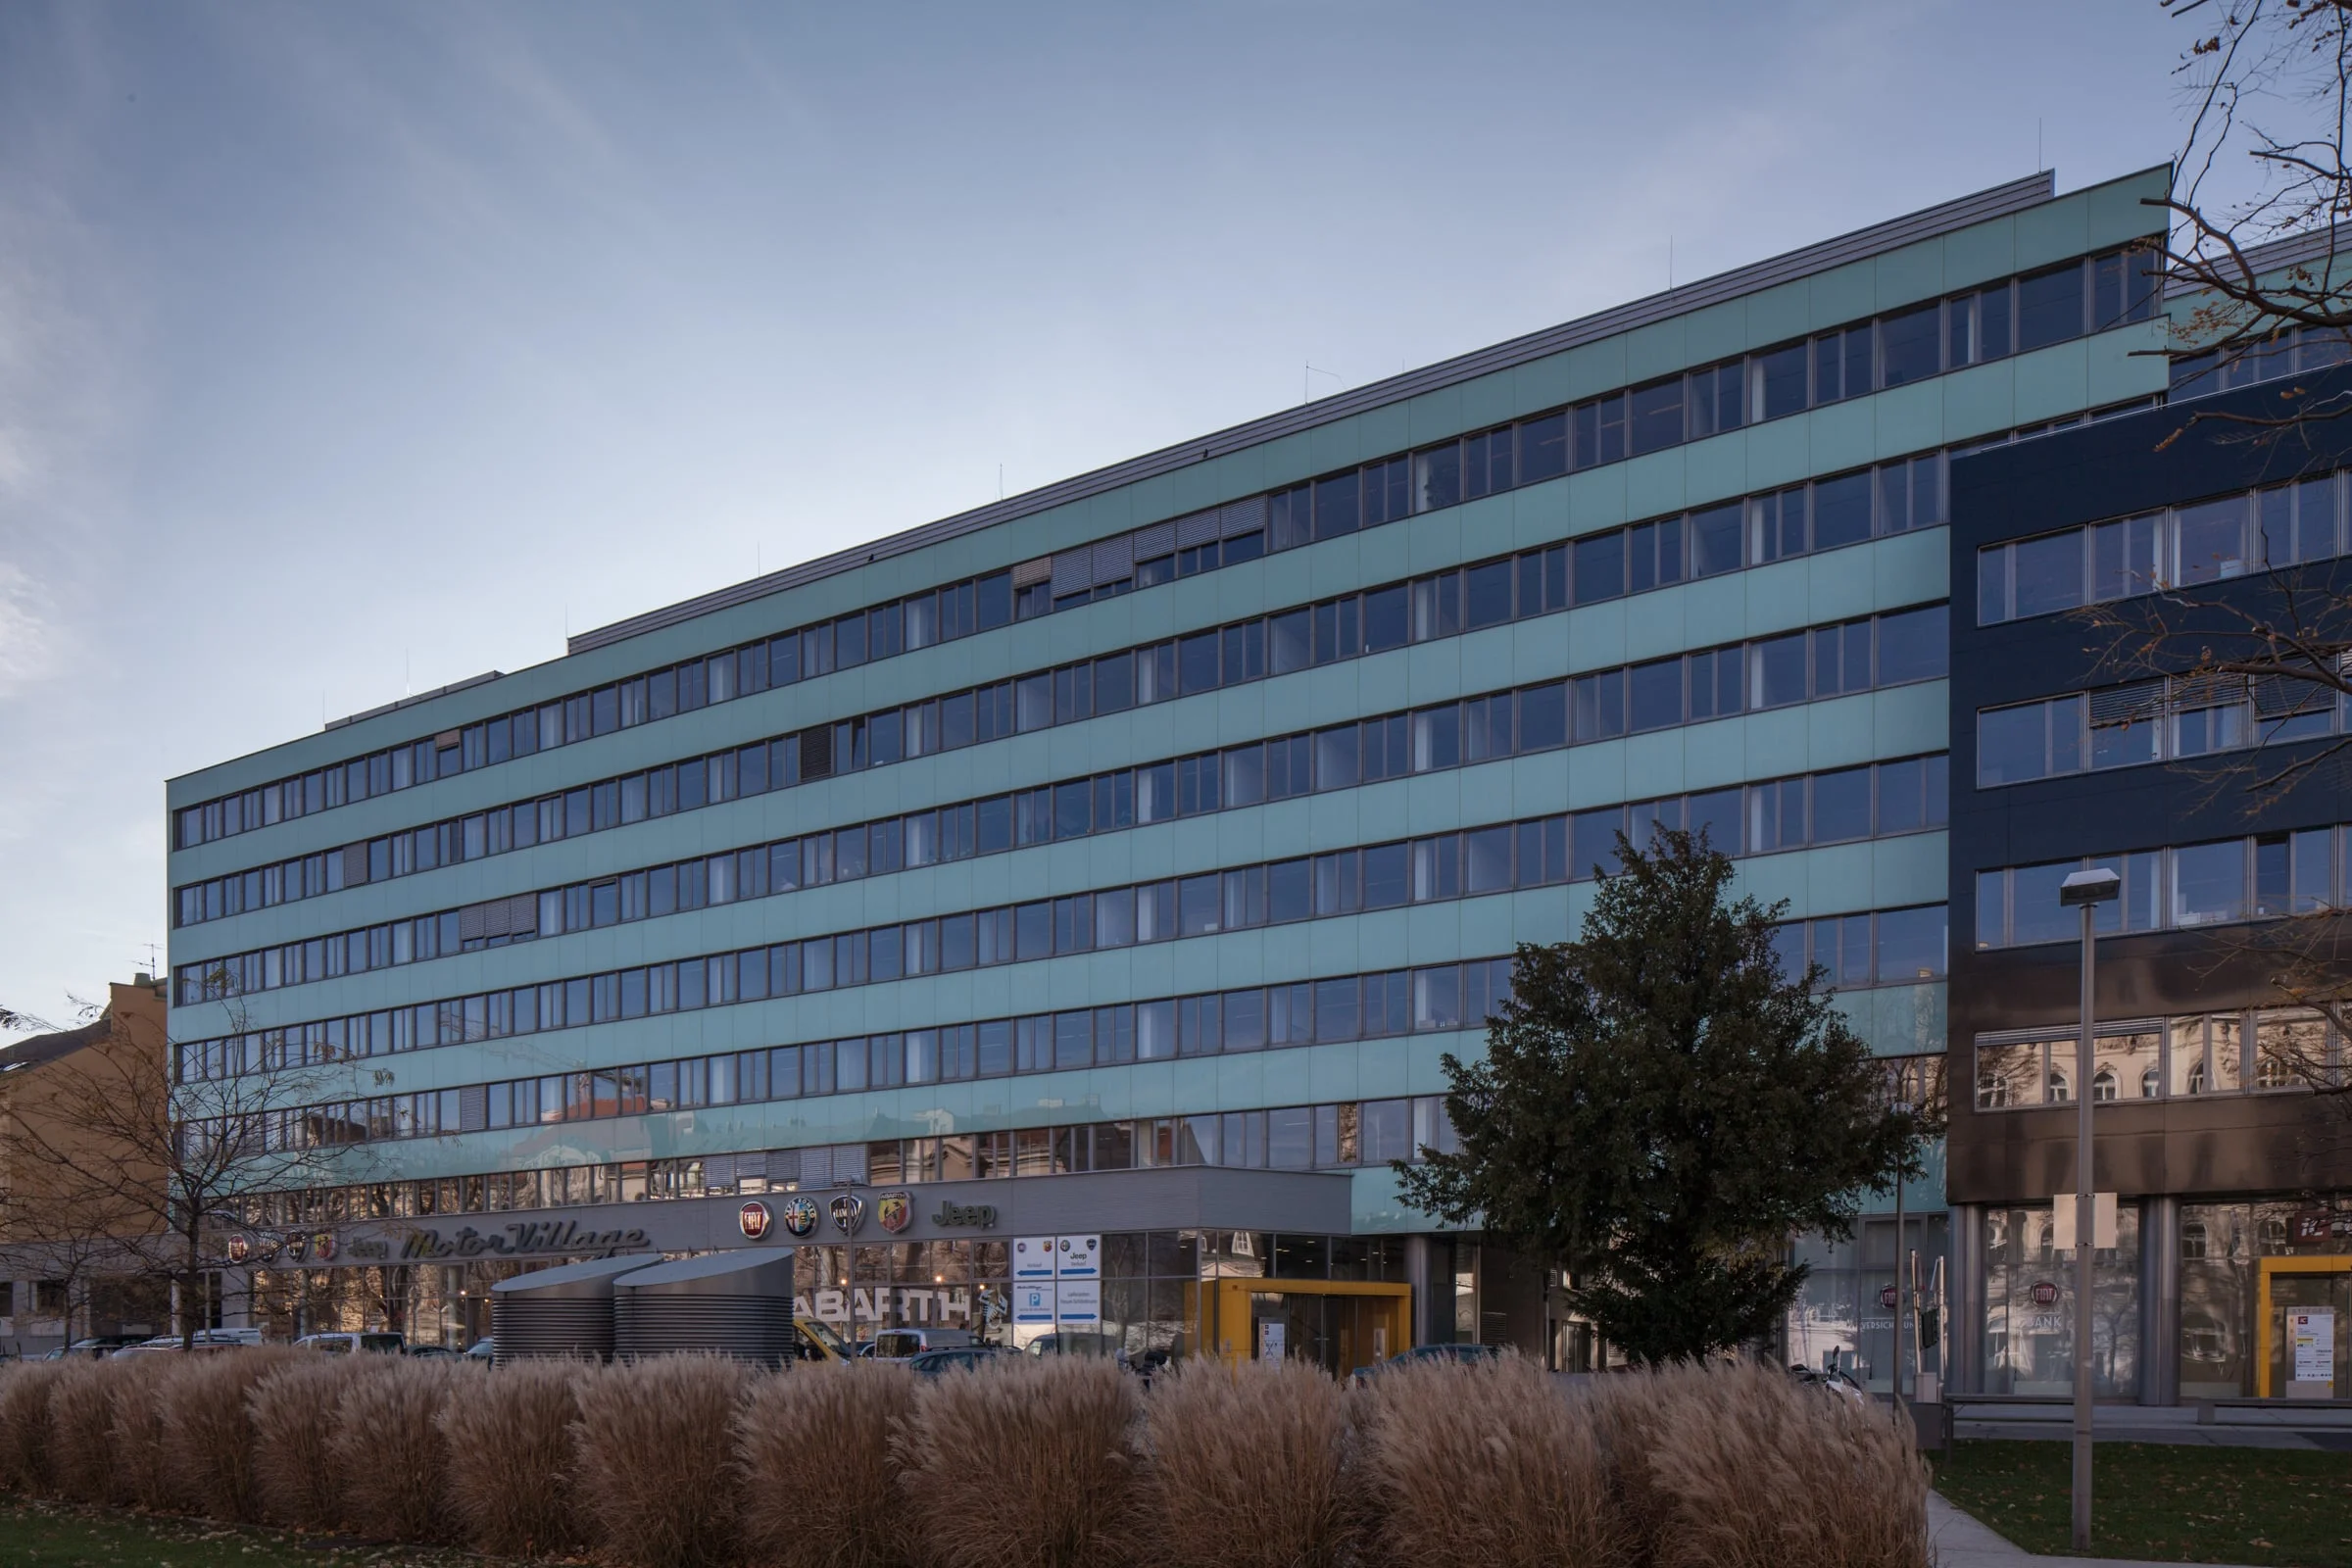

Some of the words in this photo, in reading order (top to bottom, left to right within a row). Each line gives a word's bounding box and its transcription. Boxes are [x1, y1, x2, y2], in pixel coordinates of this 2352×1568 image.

[744, 1211, 762, 1230] FIAT
[932, 1200, 995, 1230] Jeep
[1031, 1294, 1039, 1305] P
[2035, 1288, 2054, 1301] FIAT
[793, 1287, 970, 1322] ABARTH
